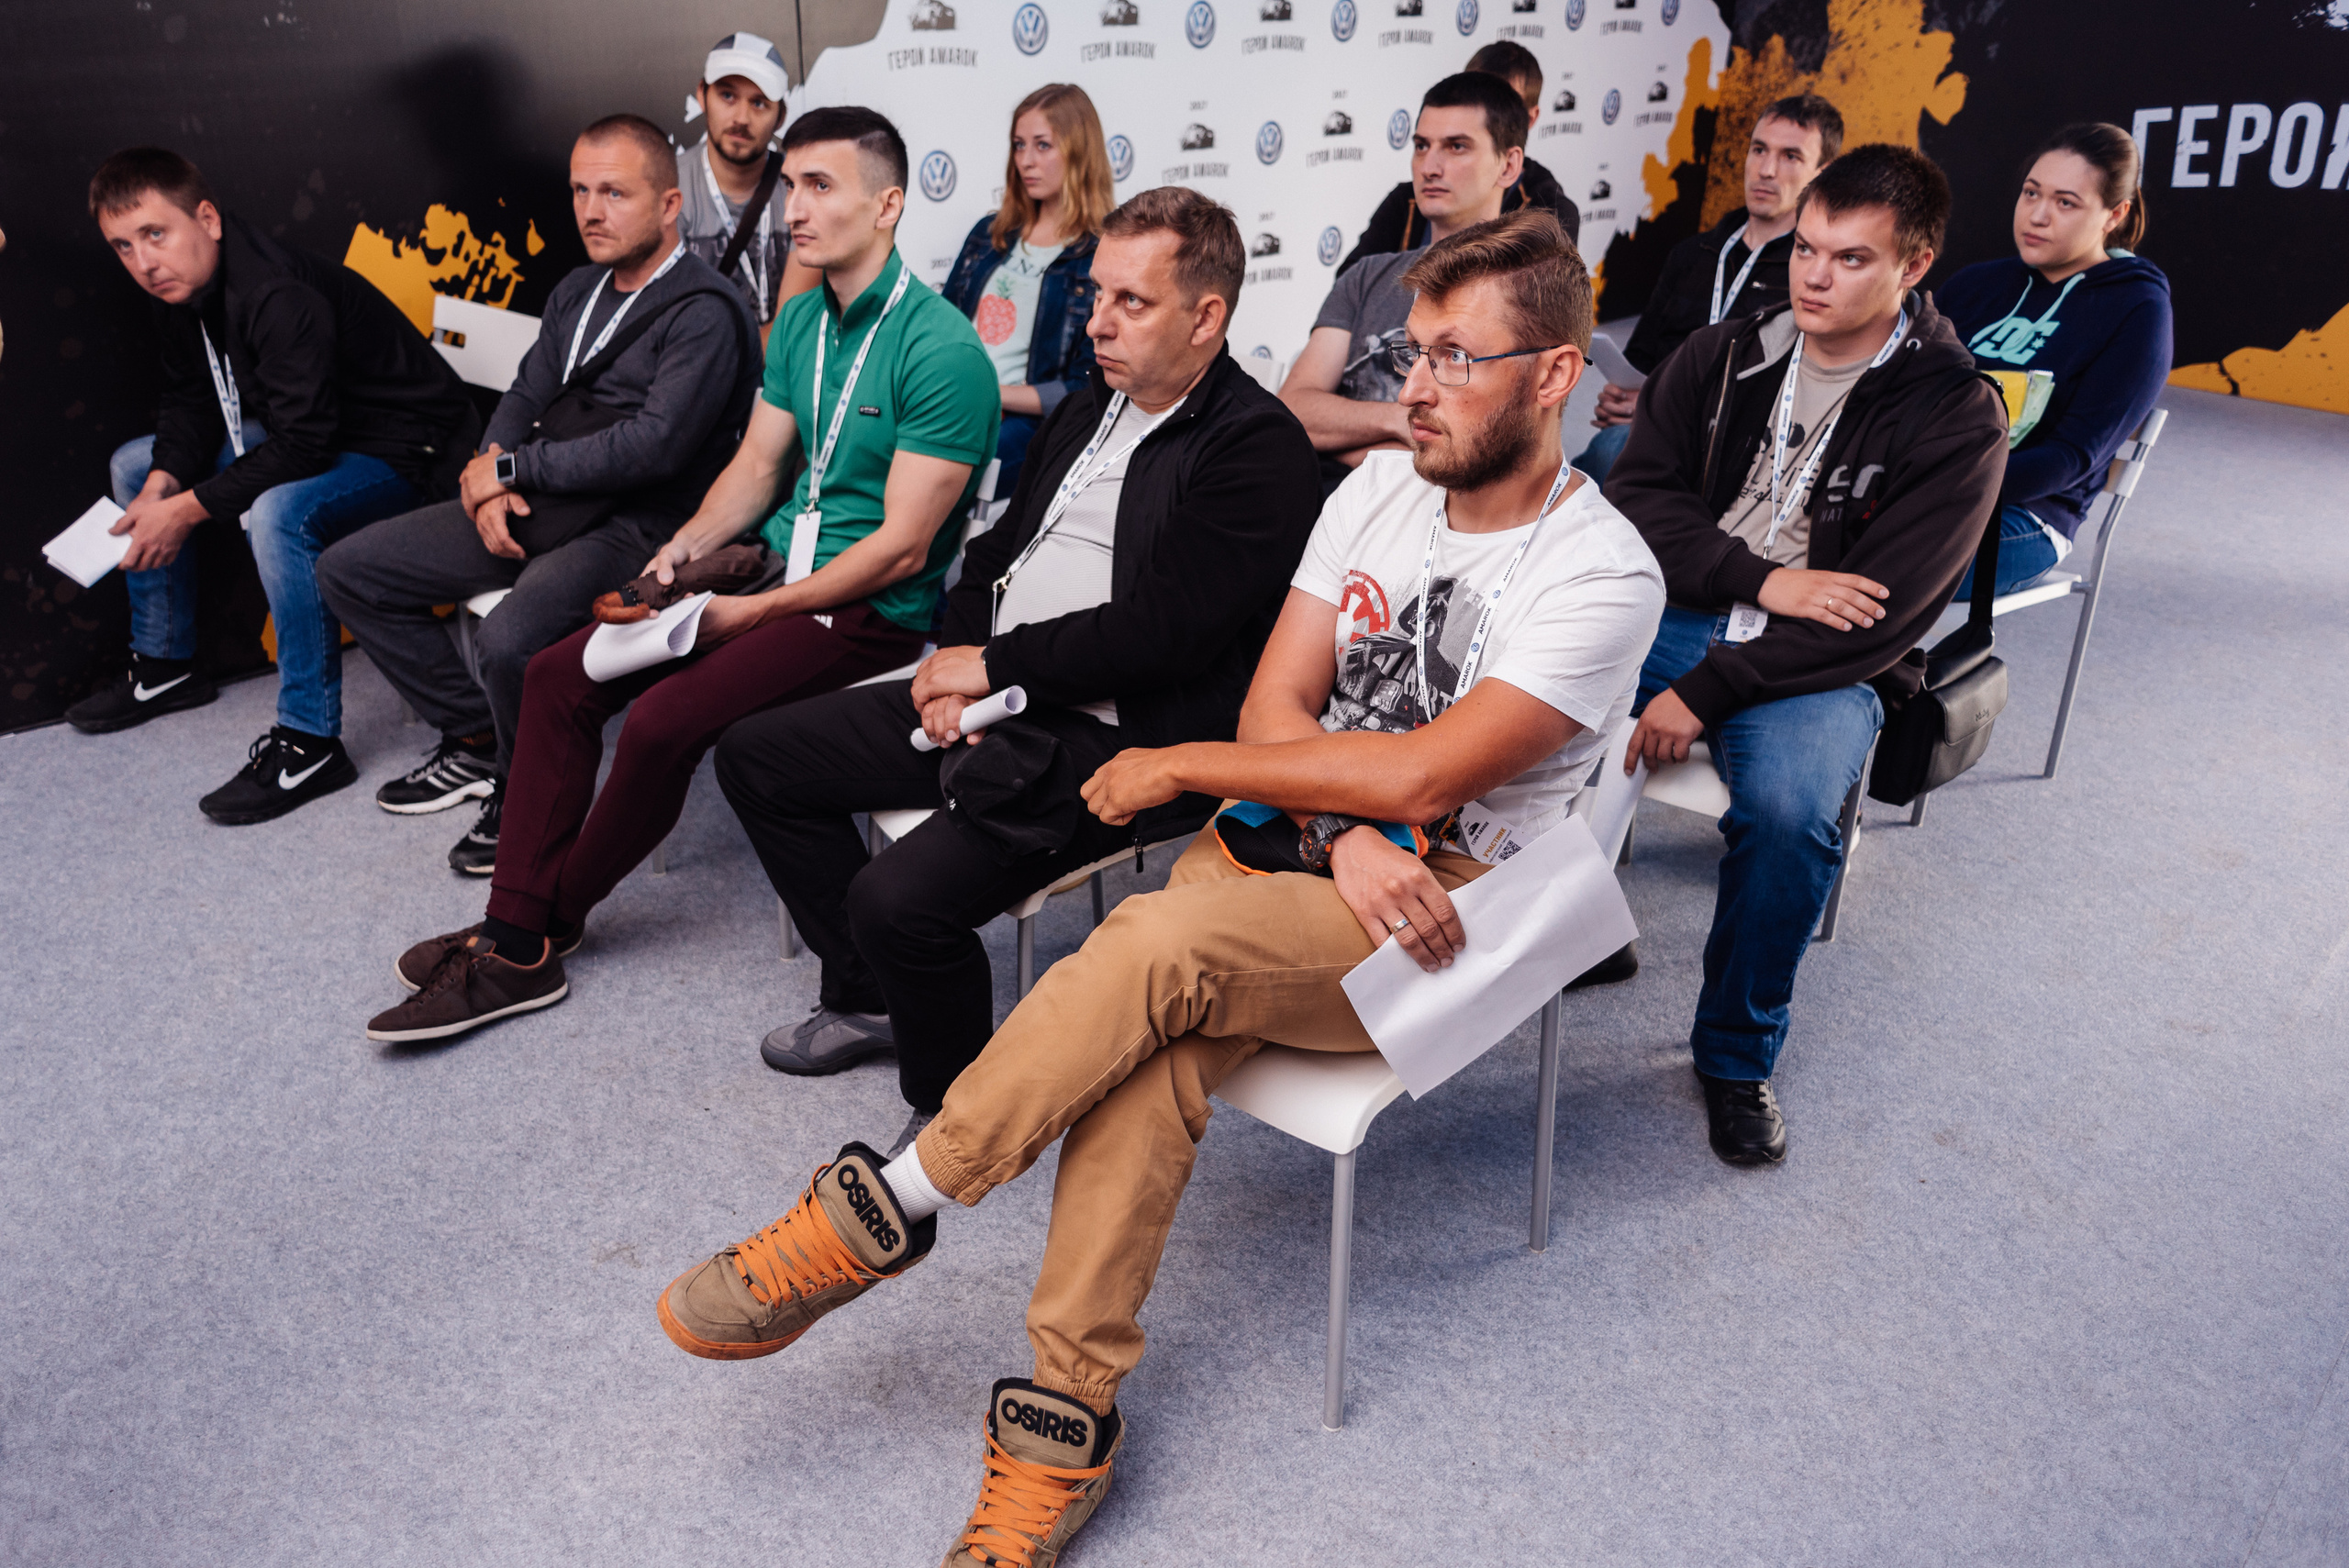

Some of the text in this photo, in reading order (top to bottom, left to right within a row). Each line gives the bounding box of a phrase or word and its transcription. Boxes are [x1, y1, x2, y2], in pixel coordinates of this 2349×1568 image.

[1070, 460, 1085, 478] AMAROK
[1547, 482, 1562, 506] AMAROK
[1503, 557, 1518, 582] AMAROK
[1478, 606, 1492, 634] AMAROK
[1460, 661, 1473, 689] AMAROK
[1483, 827, 1507, 858] УЧАСТНИК
[837, 1163, 900, 1253] OSIRIS
[1001, 1397, 1088, 1448] OSIRIS
